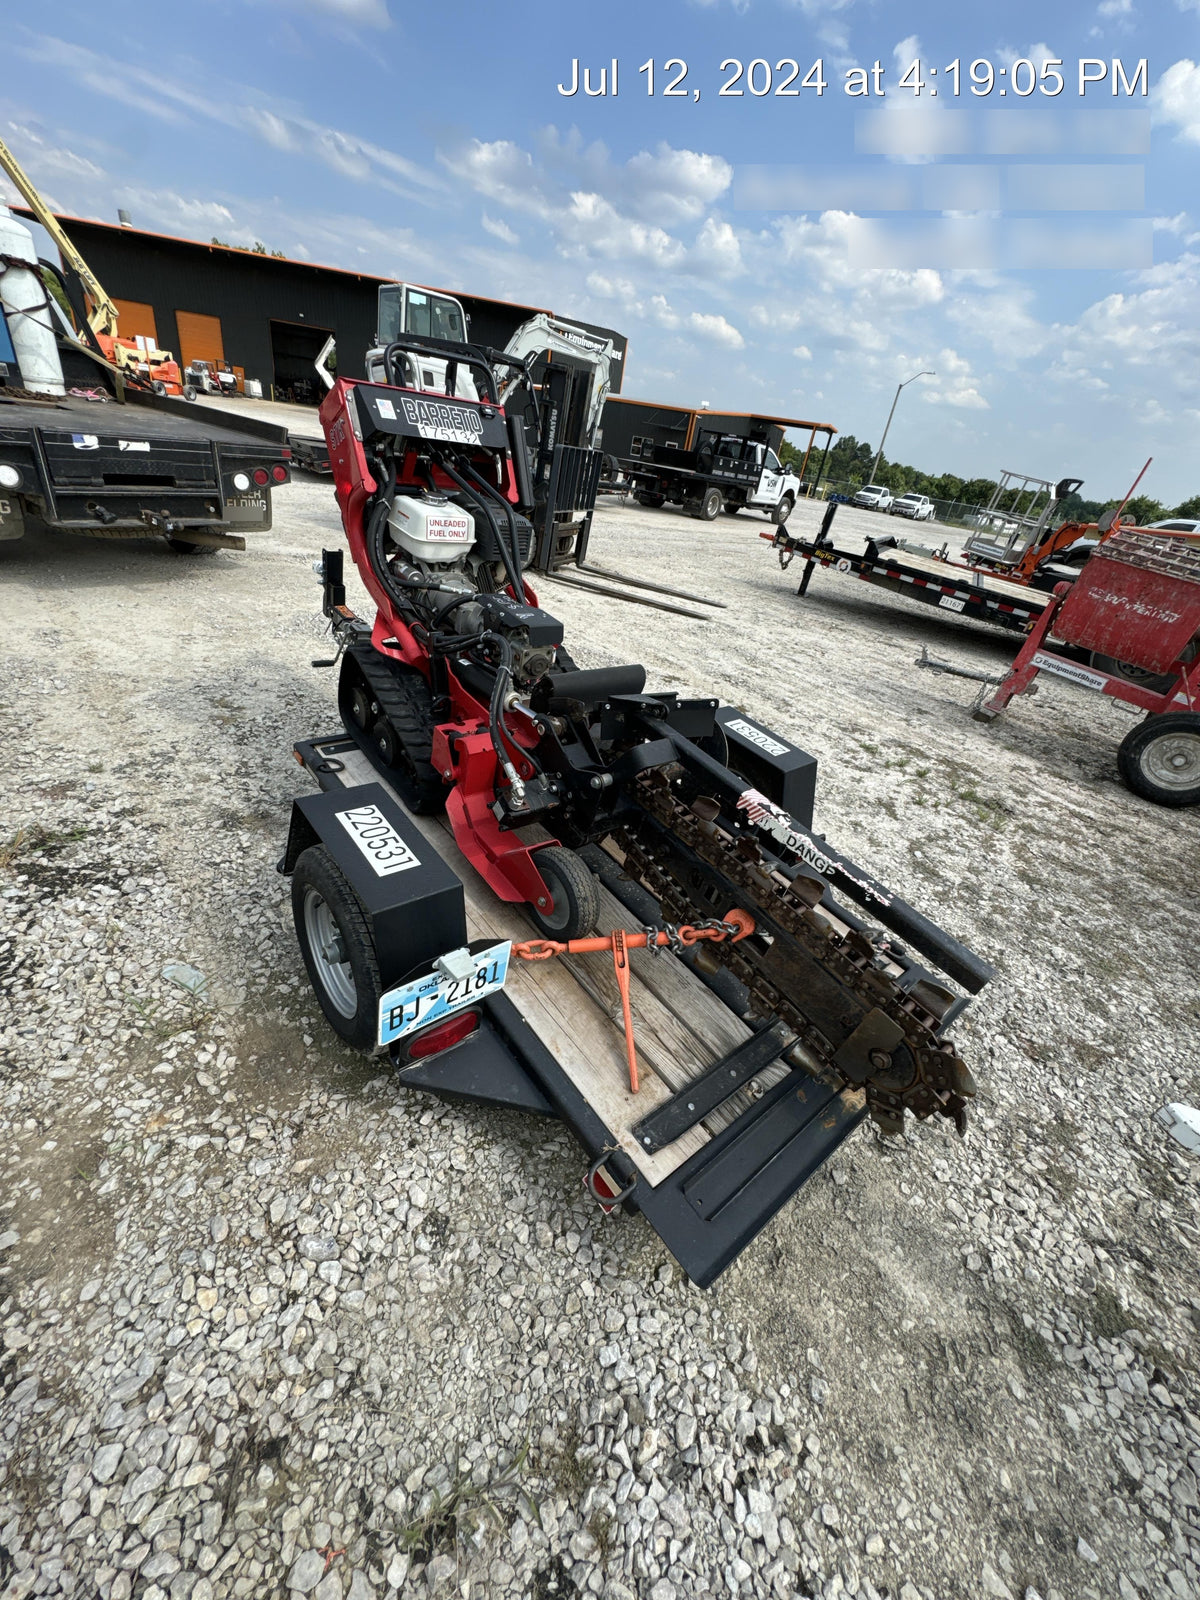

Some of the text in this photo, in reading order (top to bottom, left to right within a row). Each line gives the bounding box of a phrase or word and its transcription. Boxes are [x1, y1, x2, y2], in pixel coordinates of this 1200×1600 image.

[401, 397, 484, 434] BARRETO
[547, 409, 558, 450] KOMATSU
[420, 425, 479, 444] 175132
[429, 519, 467, 528] UNLEADED
[429, 529, 466, 538] FUEL ONLY
[1042, 659, 1103, 687] EquipmentShare
[729, 722, 786, 755] 220531
[343, 807, 414, 870] 220531
